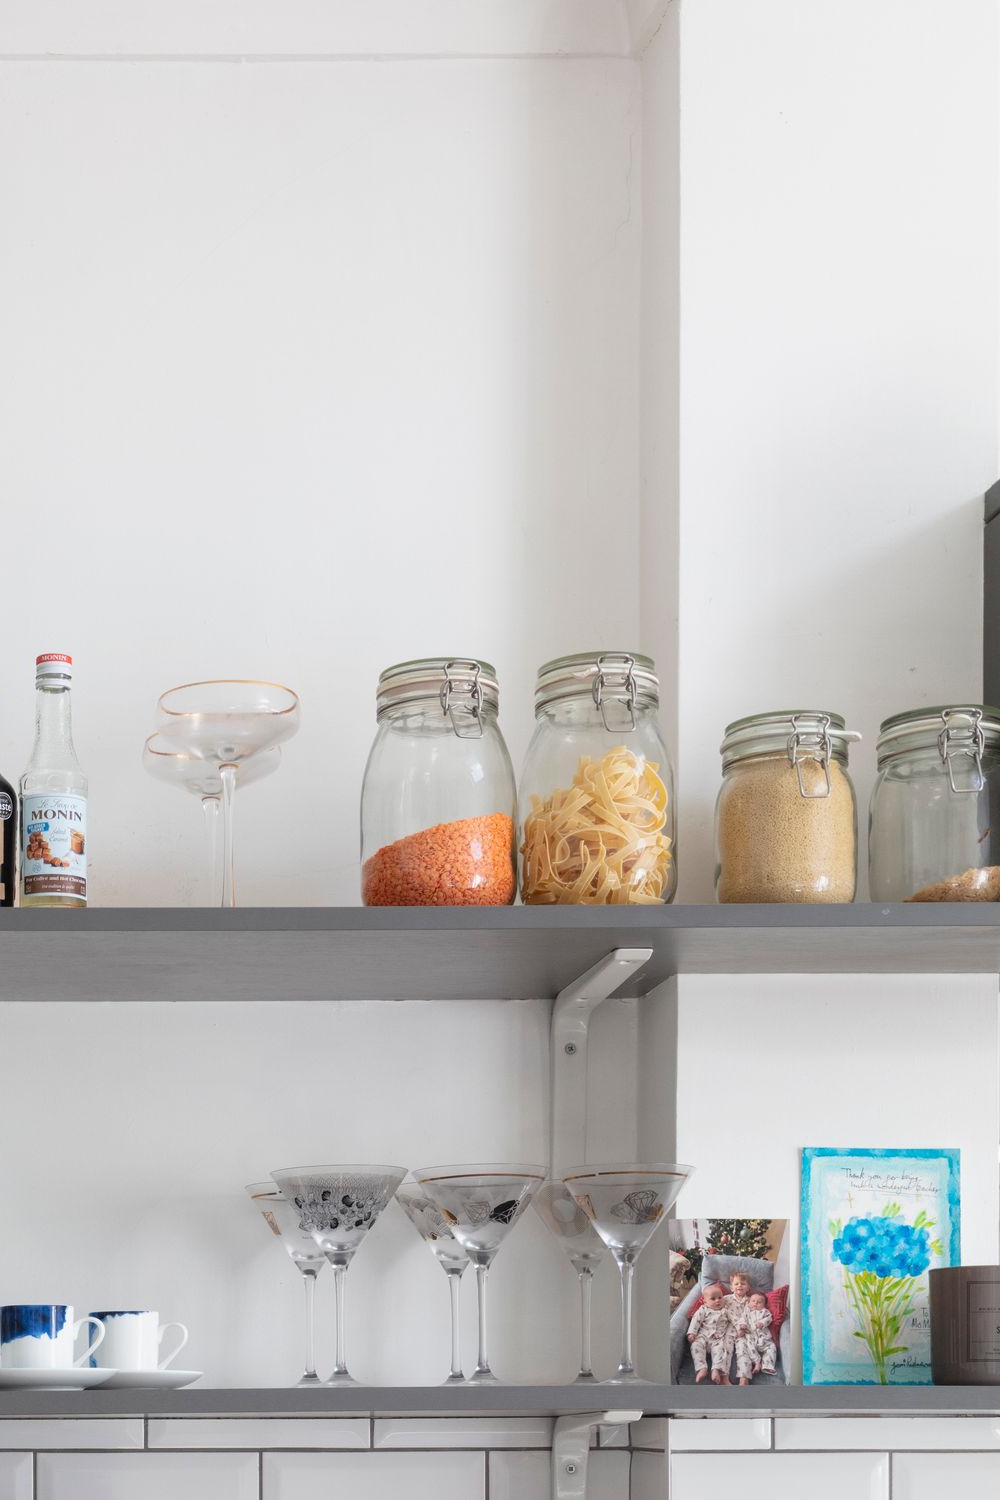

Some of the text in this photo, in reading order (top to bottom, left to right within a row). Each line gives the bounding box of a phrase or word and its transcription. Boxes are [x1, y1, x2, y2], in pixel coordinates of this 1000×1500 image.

[31, 809, 82, 822] MONIN
[840, 1167, 865, 1180] Thank
[920, 1307, 929, 1318] To
